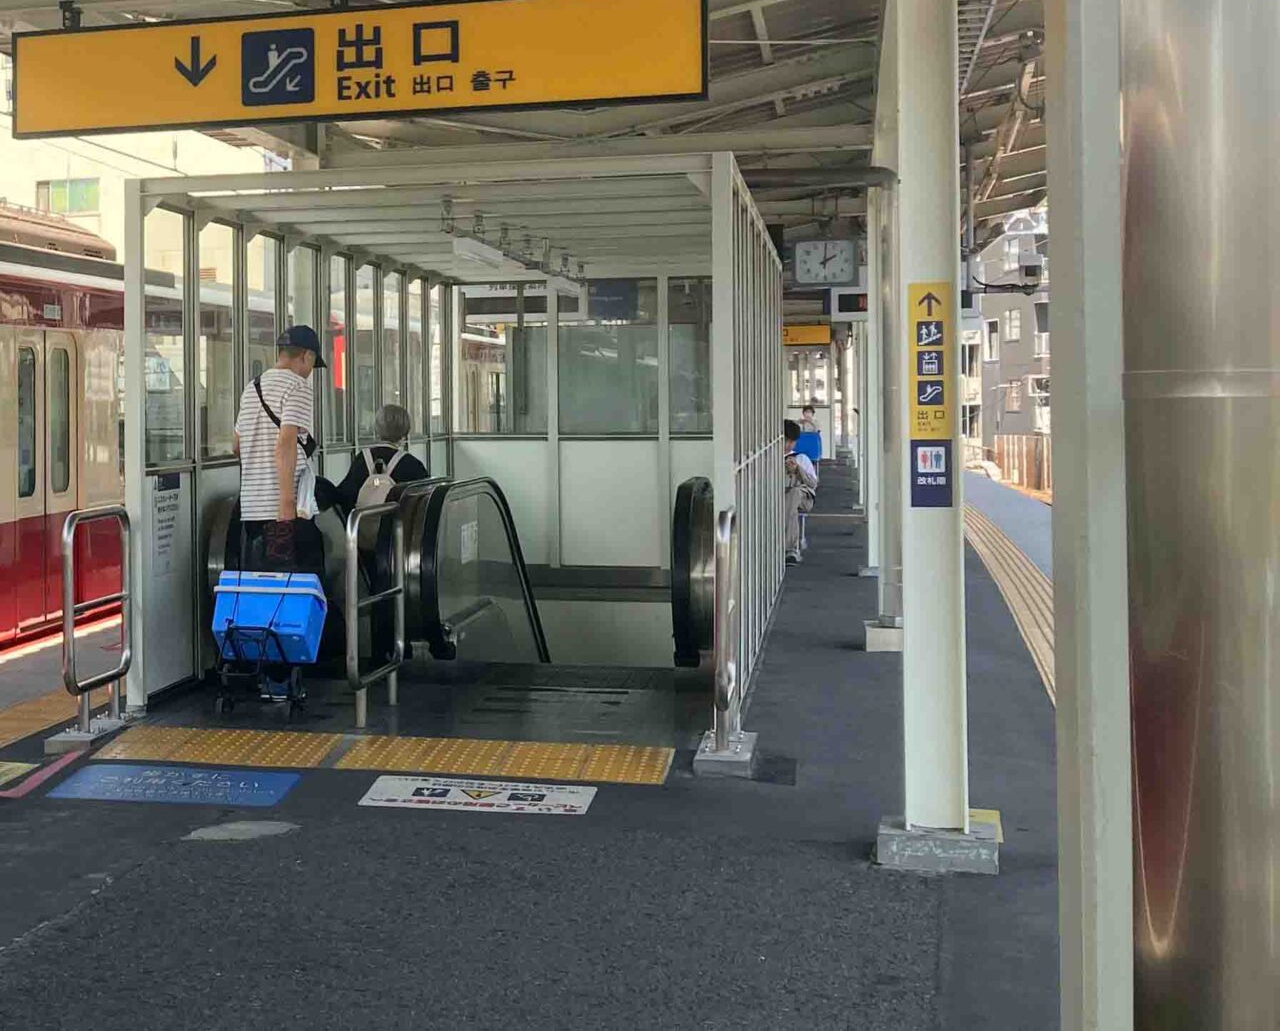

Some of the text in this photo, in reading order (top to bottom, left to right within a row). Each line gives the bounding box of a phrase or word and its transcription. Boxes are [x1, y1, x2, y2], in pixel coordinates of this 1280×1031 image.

[336, 20, 459, 71] 出口
[337, 70, 516, 101] Exit 出口 출구
[917, 410, 945, 420] 出口
